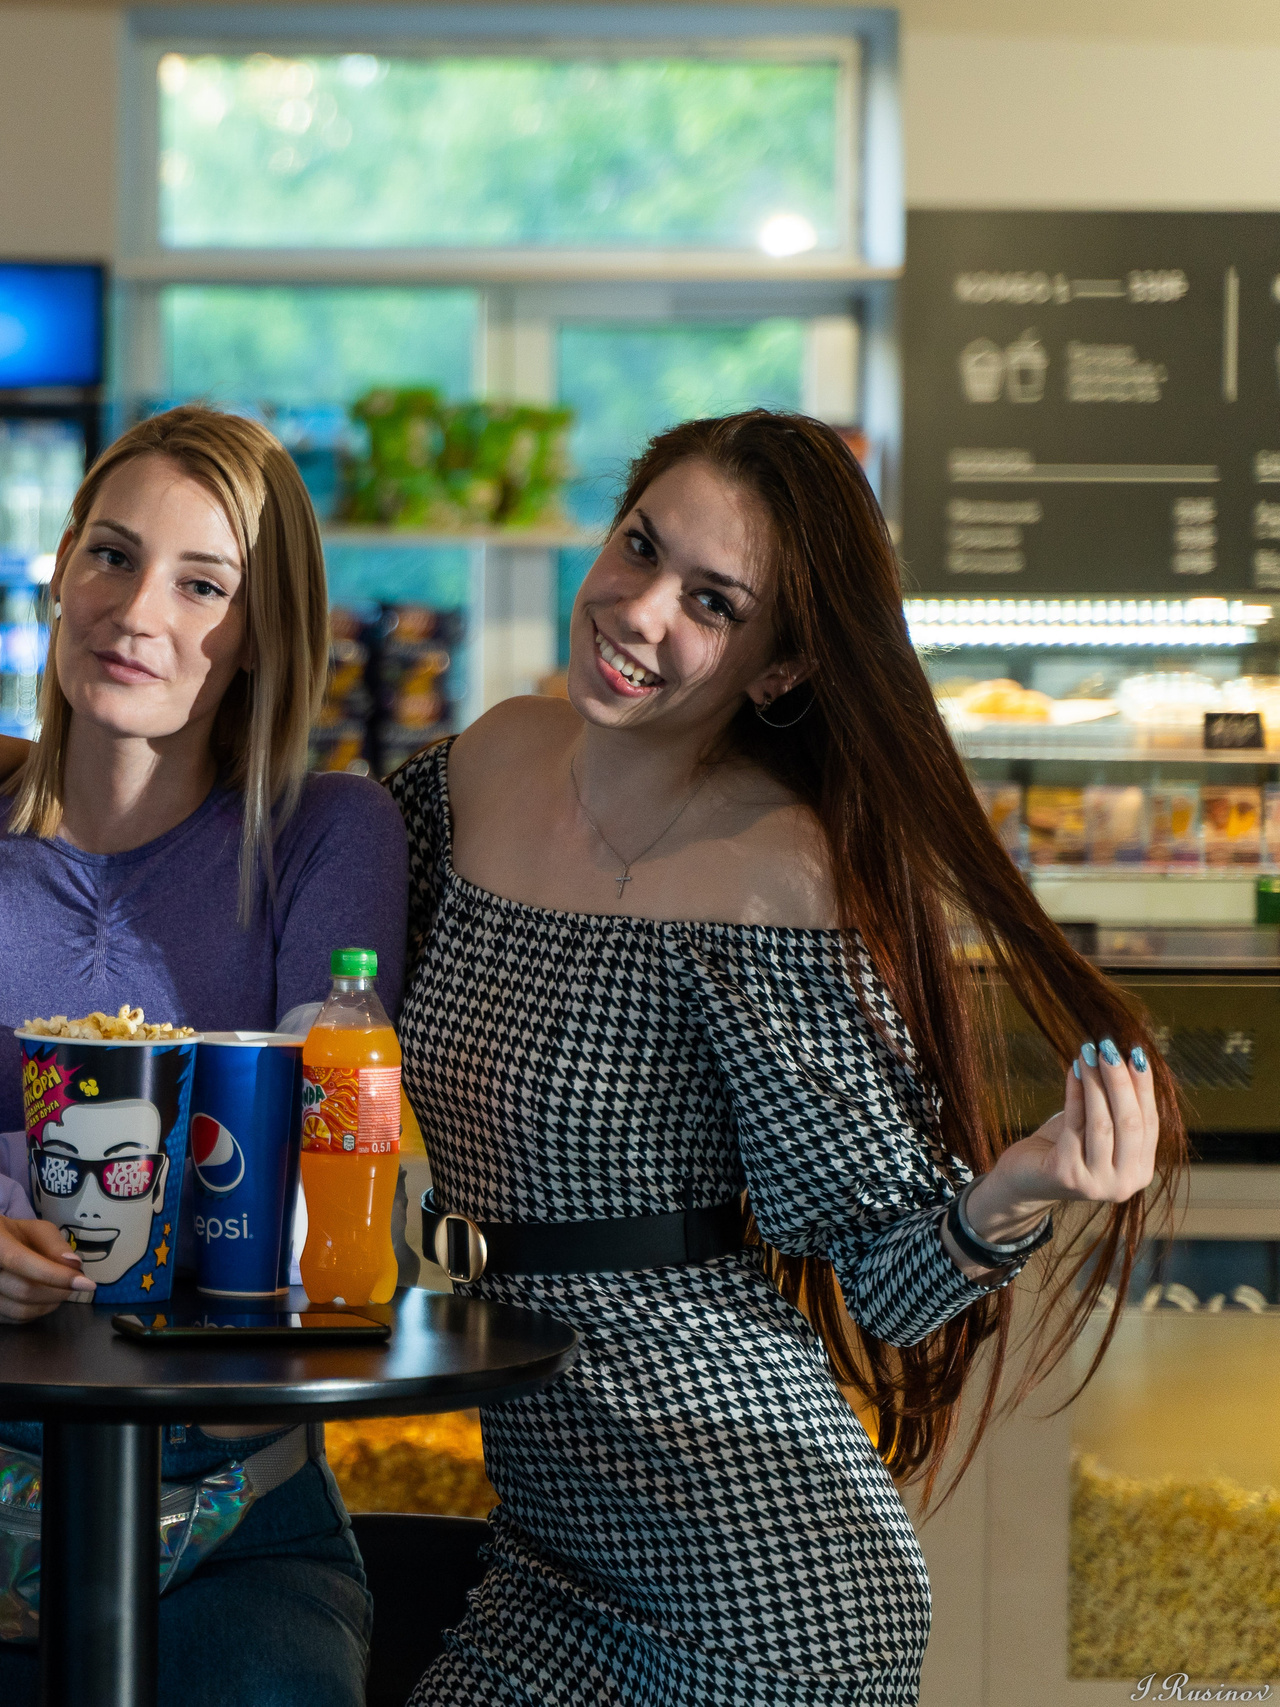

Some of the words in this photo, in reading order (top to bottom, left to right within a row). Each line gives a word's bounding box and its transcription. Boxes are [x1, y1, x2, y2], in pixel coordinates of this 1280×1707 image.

[45, 1156, 70, 1170] POP
[113, 1161, 143, 1174] POP
[42, 1168, 78, 1183] YOUR
[106, 1171, 150, 1185] YOUR
[45, 1180, 72, 1194] LIFE!
[111, 1183, 144, 1197] LIFE!
[195, 1213, 248, 1244] epsi
